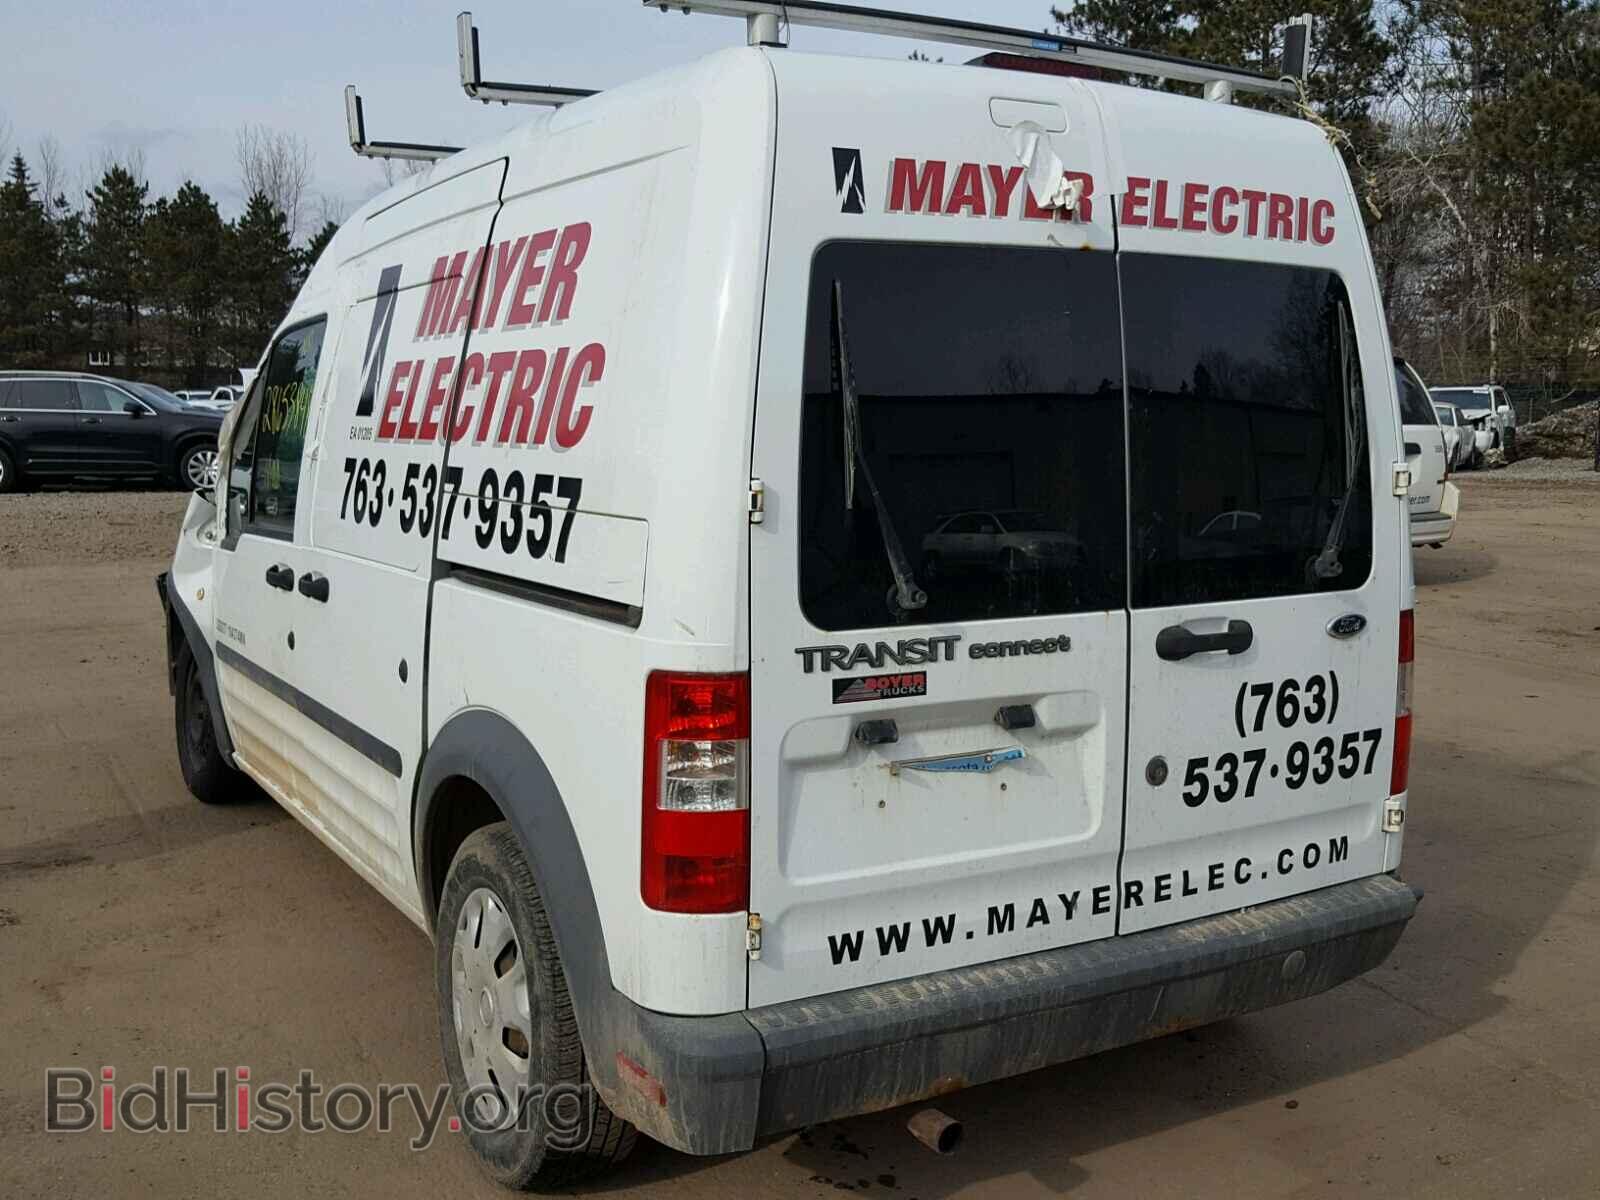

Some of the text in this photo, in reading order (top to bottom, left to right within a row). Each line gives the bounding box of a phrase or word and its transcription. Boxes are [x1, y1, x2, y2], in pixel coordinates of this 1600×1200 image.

[1122, 177, 1336, 245] ELECTRIC
[414, 221, 592, 343] MAYER
[375, 342, 606, 452] ELECTRIC
[795, 634, 1071, 673] TRANSIT connect
[1335, 616, 1362, 633] Ford
[863, 673, 925, 691] BOYER
[876, 685, 925, 697] TRUCKS
[1234, 670, 1339, 738] (763)
[828, 835, 1349, 966] WWW.MAYERELEC.COM
